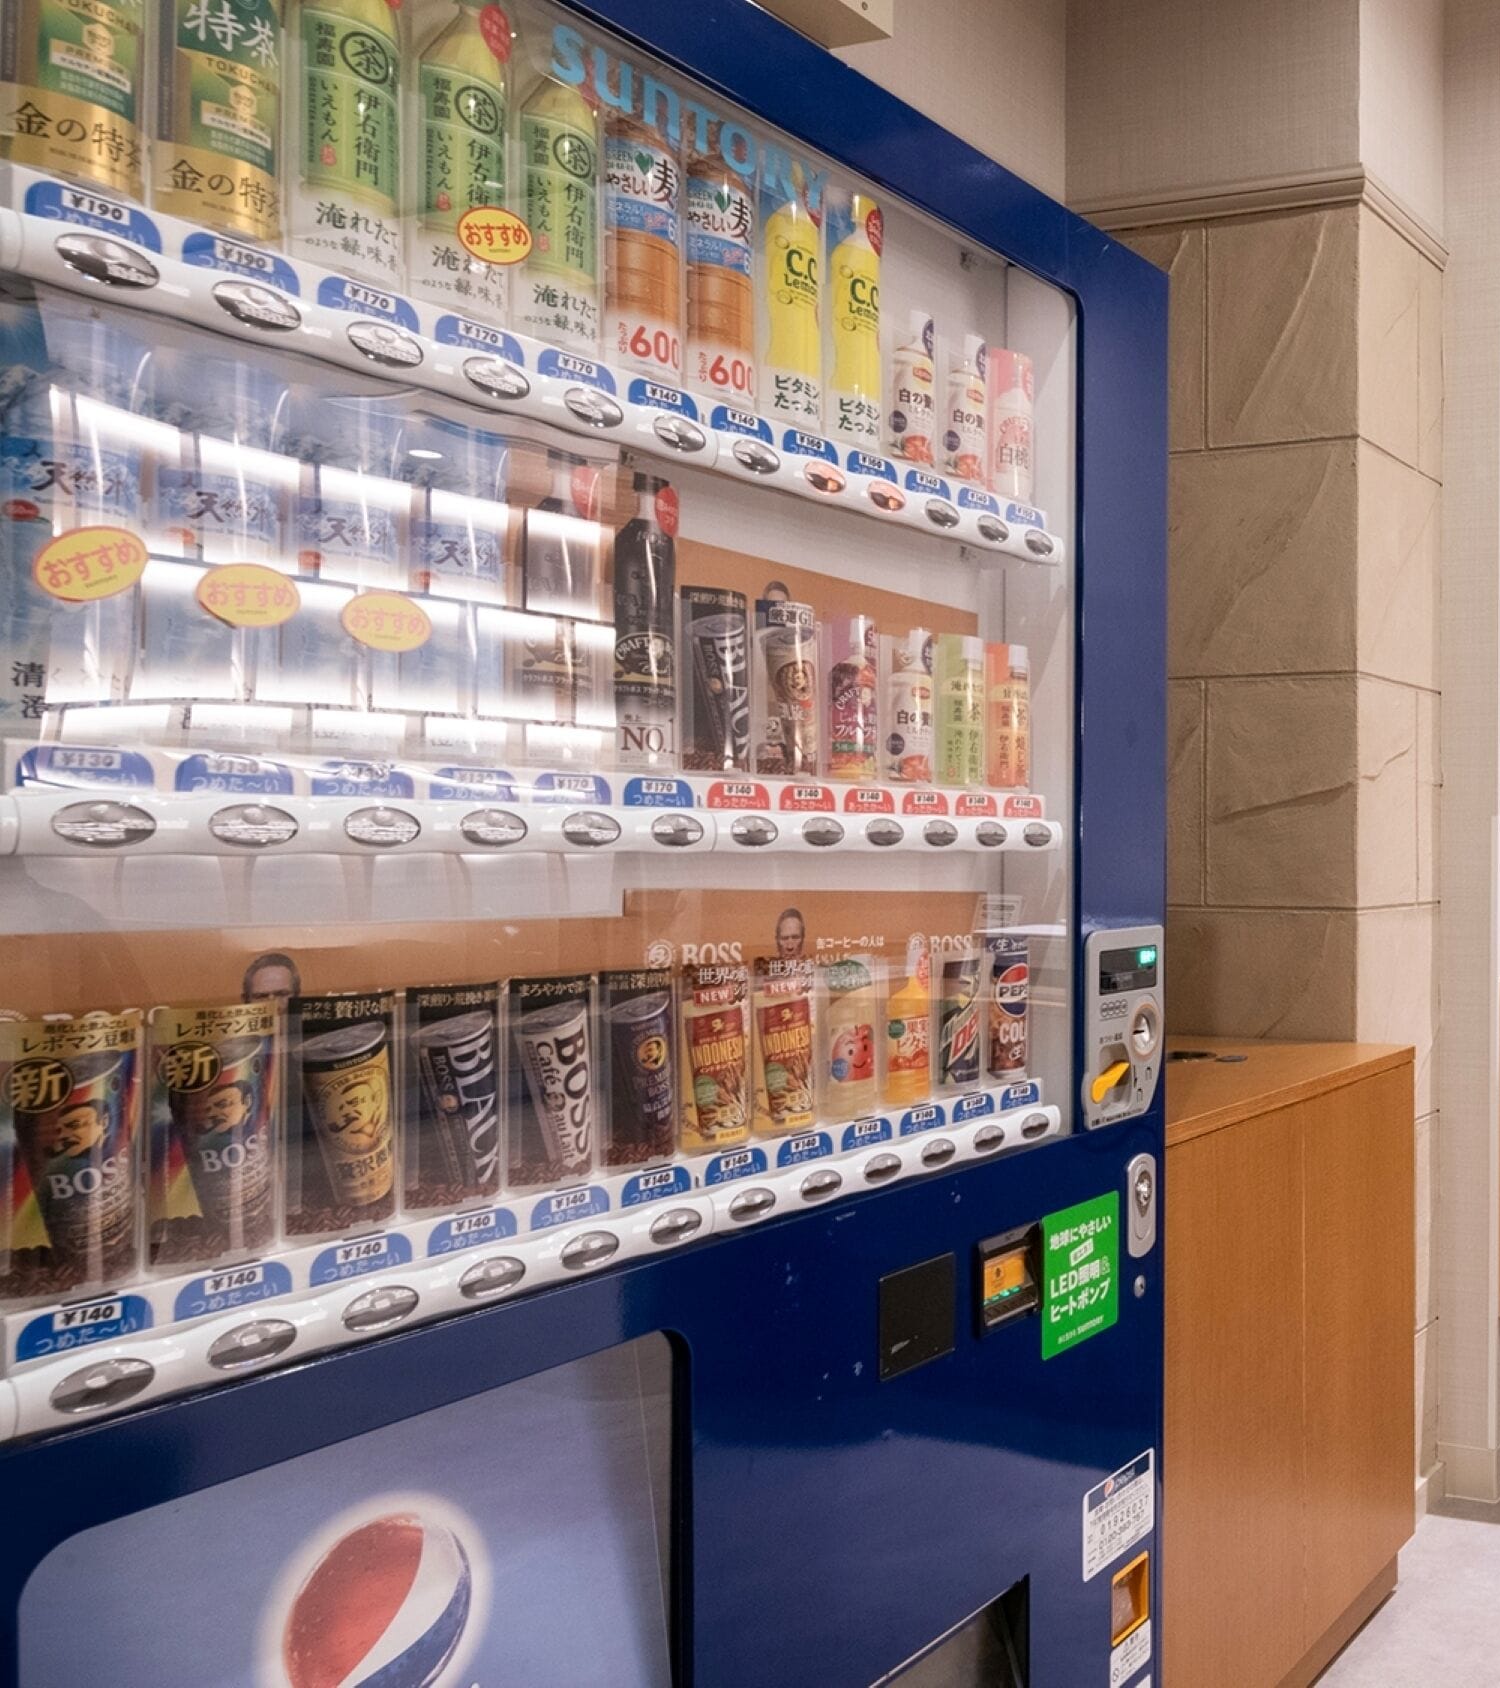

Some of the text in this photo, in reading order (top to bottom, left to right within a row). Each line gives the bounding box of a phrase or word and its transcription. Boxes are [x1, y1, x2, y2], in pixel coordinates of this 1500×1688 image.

[184, 2, 279, 68] 特茶
[350, 38, 385, 78] 茶
[320, 79, 339, 143] いえもん
[464, 90, 495, 128] 茶
[354, 88, 381, 186] 伊右衛門
[436, 130, 453, 192] いえもん
[562, 139, 589, 174] 茶
[71, 194, 124, 221] ¥190
[535, 174, 552, 233] いえもん
[464, 221, 529, 247] おすすめ
[565, 182, 587, 270] 伊右衛門
[219, 242, 268, 269] ¥190
[350, 285, 390, 309] ¥170
[462, 323, 499, 345] ¥170
[560, 354, 594, 374] ¥170
[649, 385, 679, 403] ¥140
[729, 411, 756, 426] ¥140
[44, 538, 141, 590] おすすめ
[207, 581, 294, 608] おすすめ
[350, 607, 425, 633] おすすめ
[632, 793, 685, 807] つめた〜い
[644, 782, 674, 794] ¥170
[726, 784, 753, 796] ¥140
[797, 788, 820, 798] ¥140
[857, 791, 880, 802] ¥140
[711, 797, 767, 808] あったか〜い
[699, 988, 732, 1003] NEW
[166, 1045, 216, 1090] 新
[9, 1060, 66, 1110] 新
[554, 1025, 592, 1155] BOSS
[447, 1031, 500, 1185] BLACK
[857, 1122, 879, 1134] ¥140
[198, 1125, 269, 1174] BOSS
[793, 1137, 817, 1151] ¥140
[48, 1146, 131, 1202] BOSS
[713, 1163, 762, 1183] つめた〜い
[723, 1154, 750, 1169] ¥140
[642, 1172, 672, 1188] ¥140
[554, 1193, 586, 1209] ¥140
[628, 1183, 685, 1205] つめた〜い
[454, 1215, 491, 1232] ¥140
[539, 1204, 602, 1229] つめた〜い
[438, 1227, 508, 1252] つめた〜い
[1049, 1214, 1112, 1251] 地球にやさしい
[340, 1242, 383, 1262] ¥140
[322, 1252, 402, 1281] つめた〜い
[210, 1270, 258, 1292] ¥140
[189, 1284, 280, 1313] つめた〜い
[1049, 1278, 1111, 1323] ヒートポンプ
[62, 1306, 115, 1327] ¥140
[34, 1319, 138, 1355] つめた〜い
